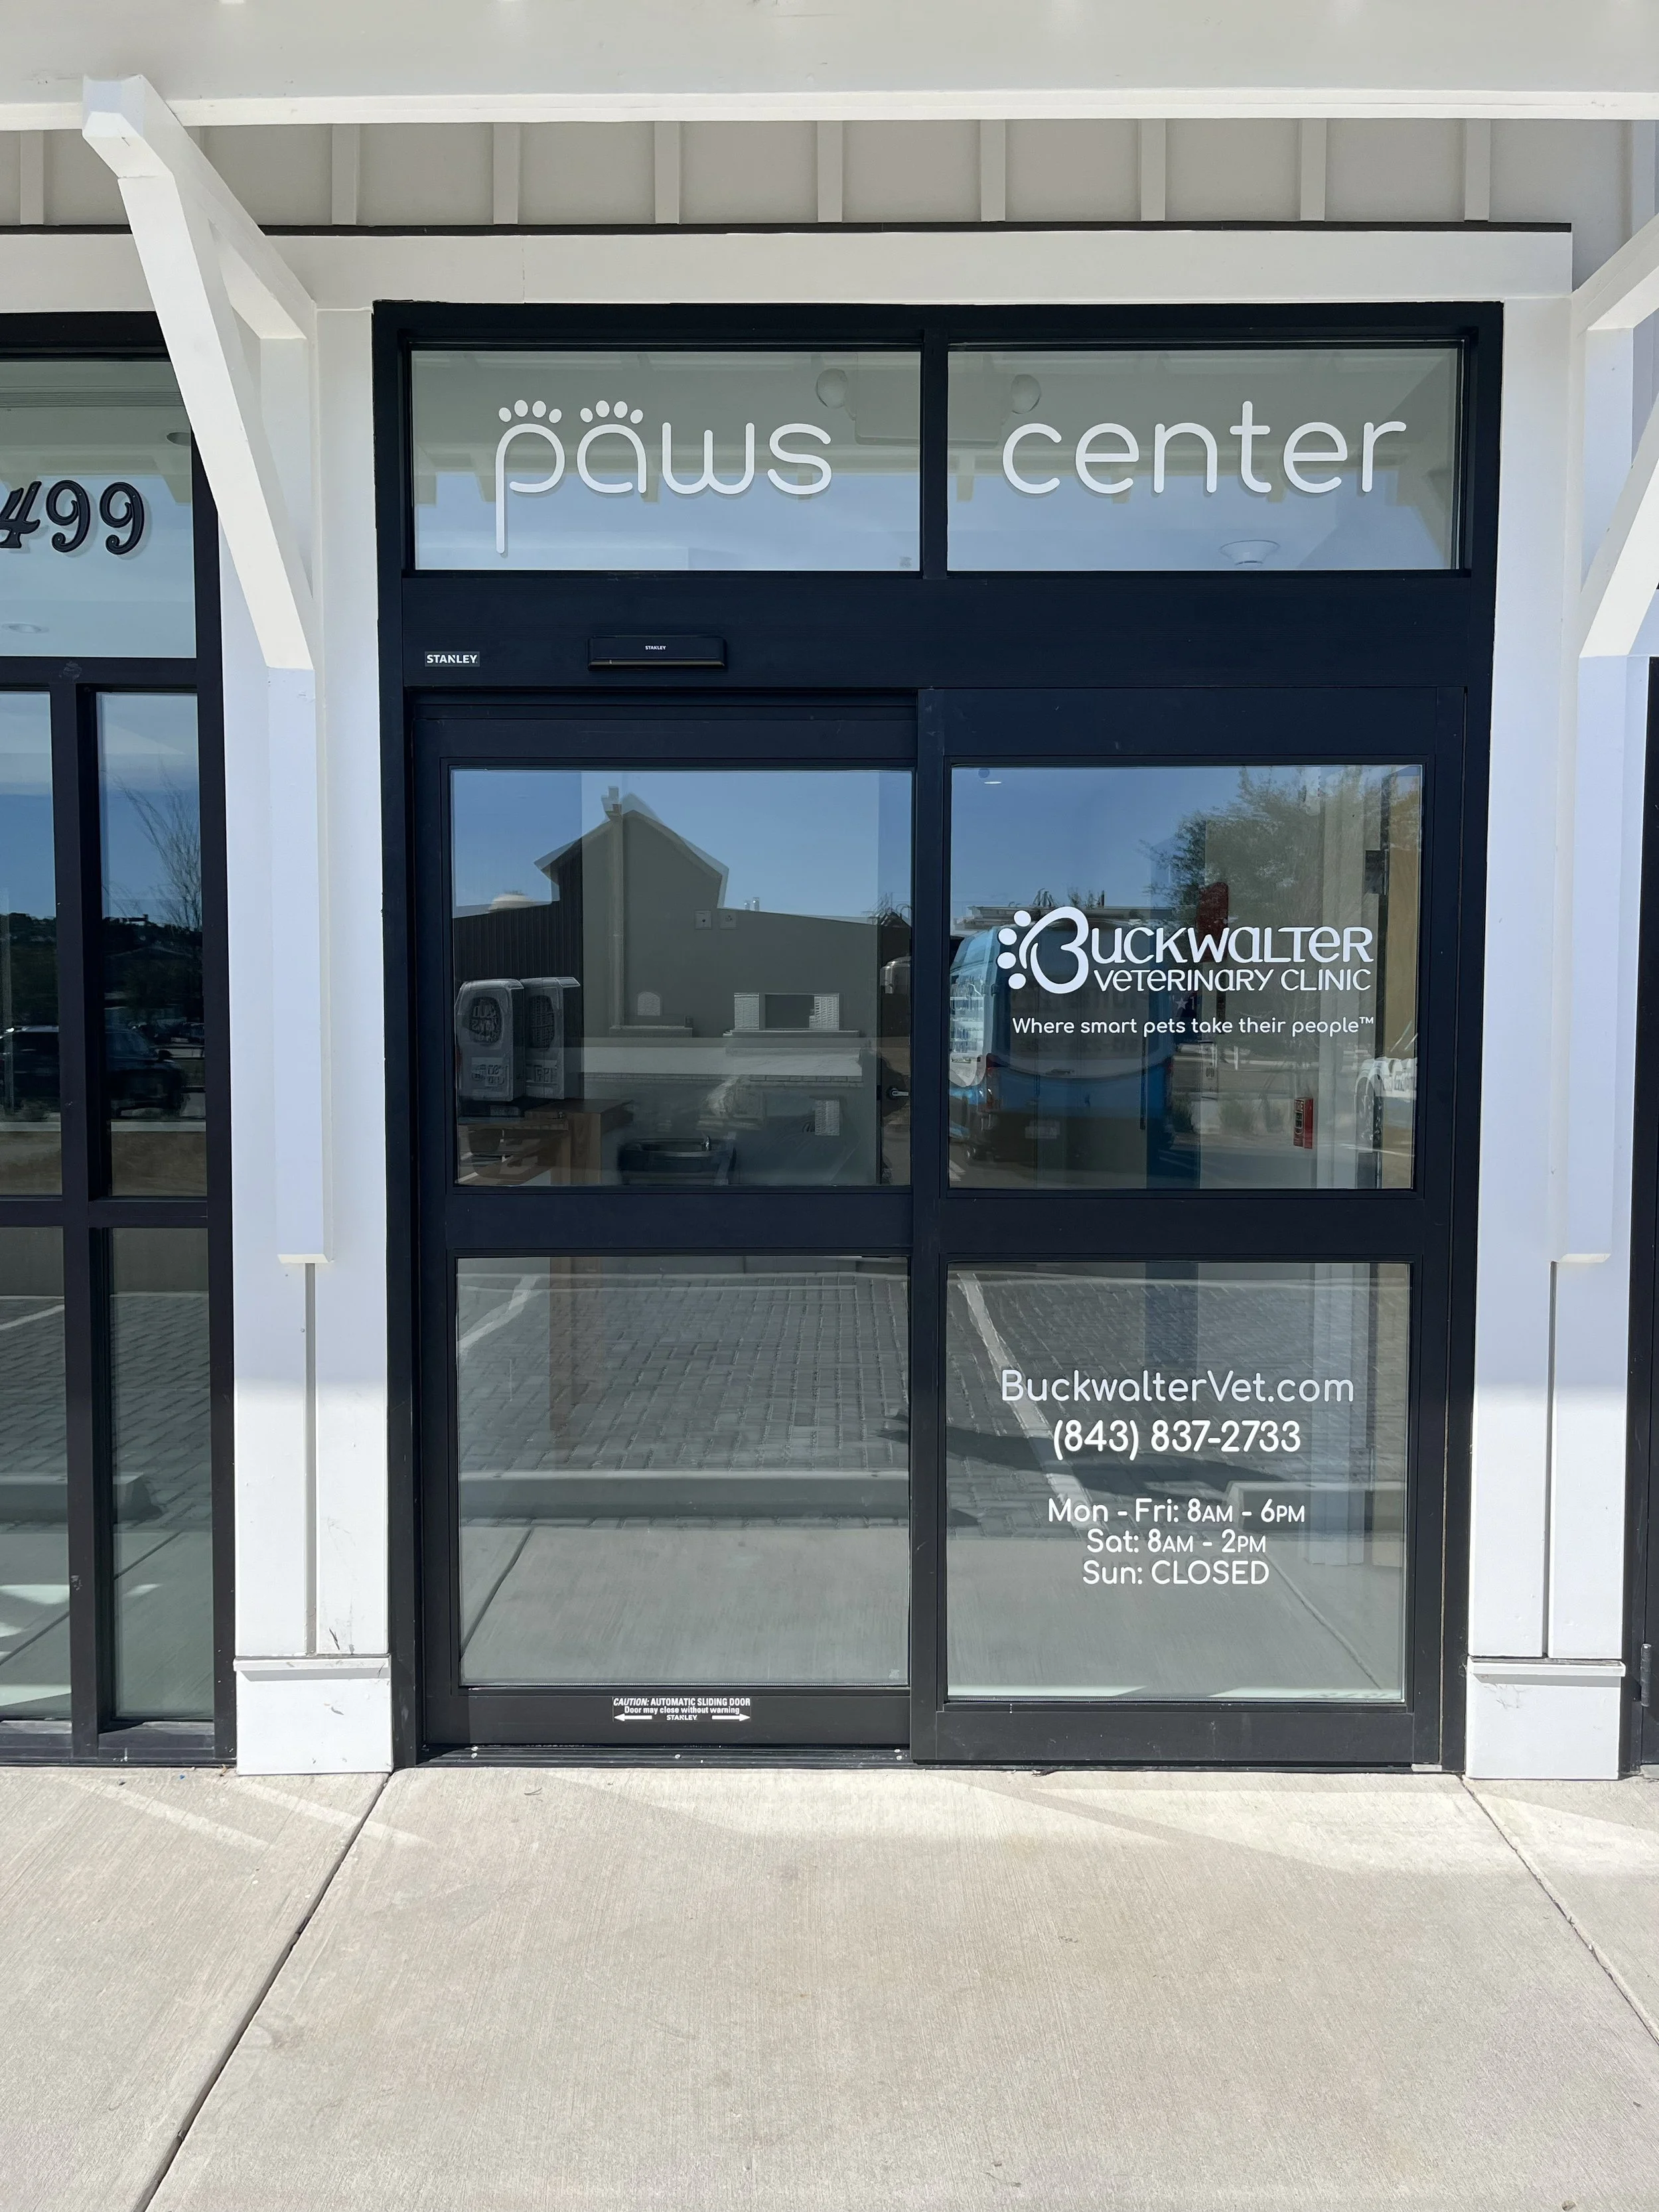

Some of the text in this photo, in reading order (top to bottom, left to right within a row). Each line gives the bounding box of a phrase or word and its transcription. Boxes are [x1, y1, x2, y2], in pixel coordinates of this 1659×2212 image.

[496, 400, 1407, 554] paws center
[0, 479, 145, 555] 499
[427, 654, 478, 664] STANLEY
[1281, 968, 1372, 992] CLINIC
[1012, 1017, 1075, 1034] Where
[1080, 1018, 1137, 1034] smart
[1143, 1018, 1186, 1038] pets
[1191, 1017, 1233, 1034] take
[1238, 1017, 1286, 1034] their
[1001, 1369, 1354, 1402] BuckwalterVet.com
[1053, 1420, 1301, 1461] (843) 837-2733
[1048, 1498, 1108, 1522] Mon
[1135, 1498, 1179, 1522] Fri:
[1187, 1498, 1233, 1522] 8AM
[1261, 1498, 1305, 1522] 6PM
[1086, 1528, 1139, 1553] Sat:
[1147, 1528, 1194, 1553] 8AM
[1221, 1528, 1267, 1553] 2PM
[1082, 1560, 1269, 1585] Sun: CLOSED
[613, 1698, 751, 1706] CAUTION: AUTOMATIC SLIDING DOOR
